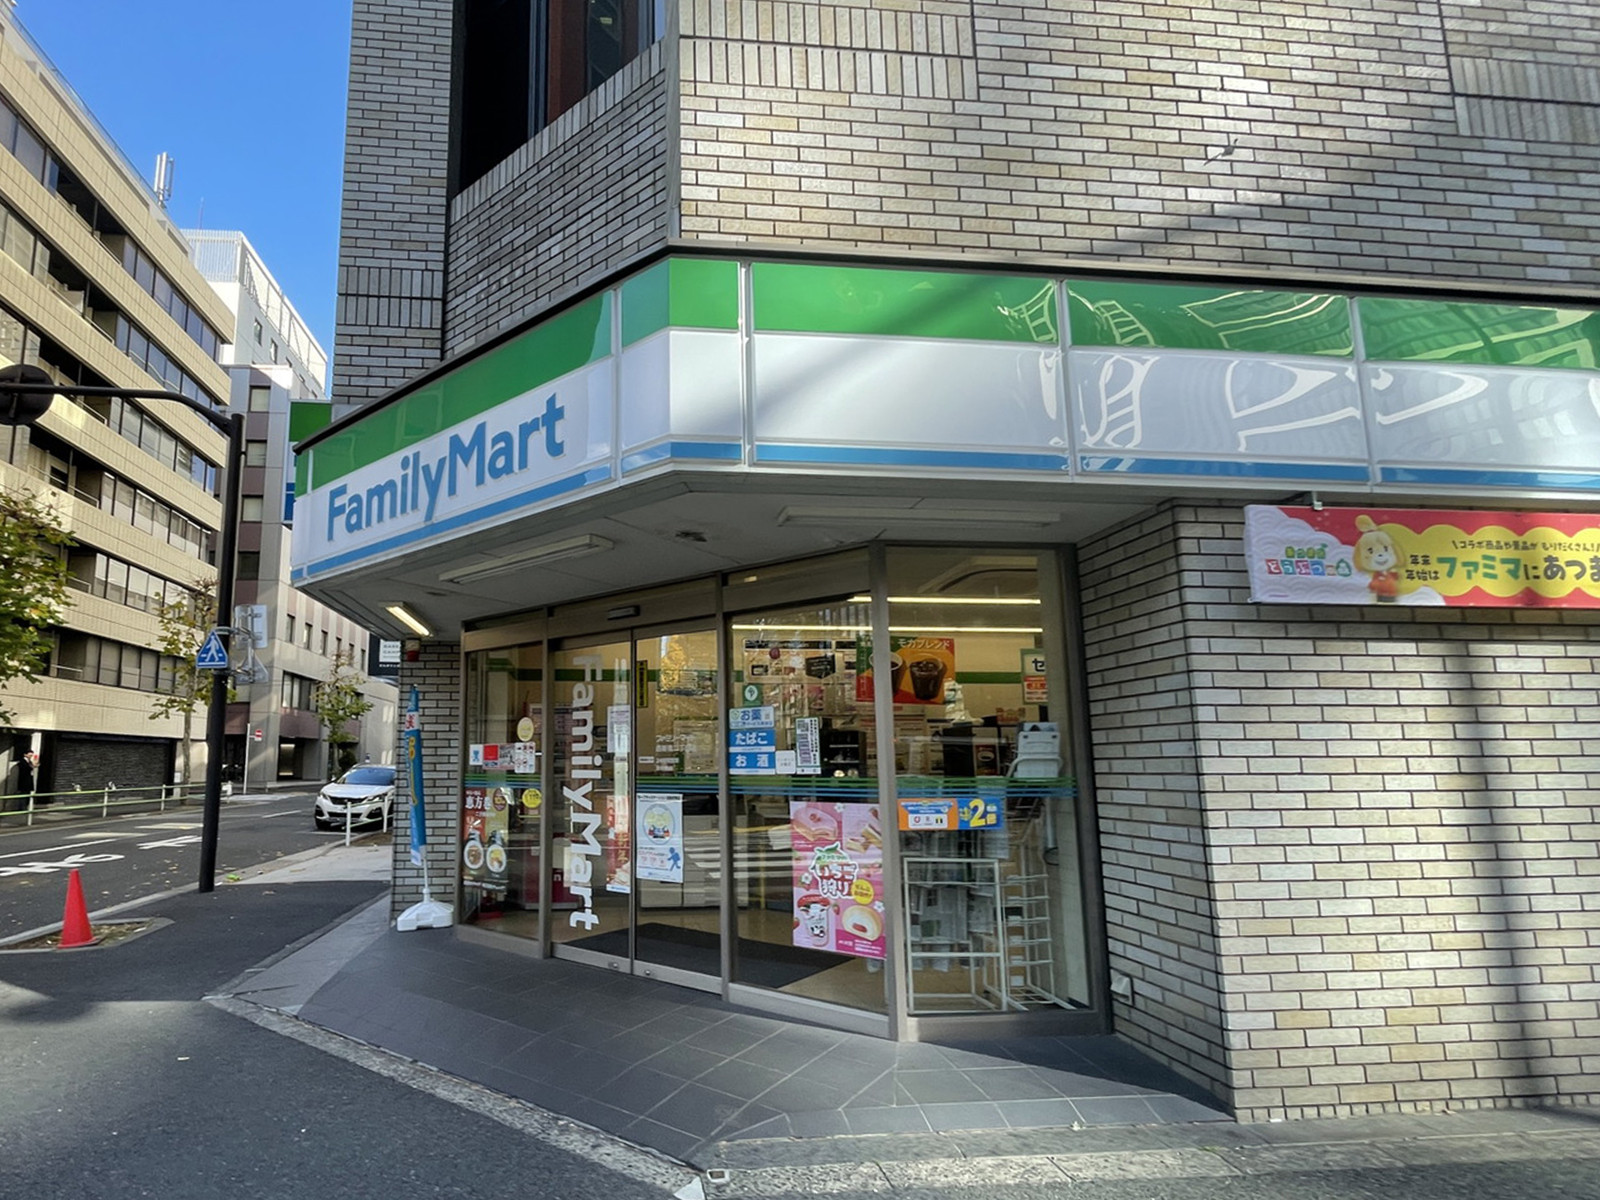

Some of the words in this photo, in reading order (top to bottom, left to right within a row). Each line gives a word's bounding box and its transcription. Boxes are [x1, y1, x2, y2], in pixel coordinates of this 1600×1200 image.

[327, 392, 566, 542] FamilyMart
[897, 638, 950, 649] モカブレンド
[735, 732, 768, 745] たばこ
[563, 653, 603, 930] FamilyMart
[815, 863, 857, 880] いちご
[821, 878, 849, 896] 狩り
